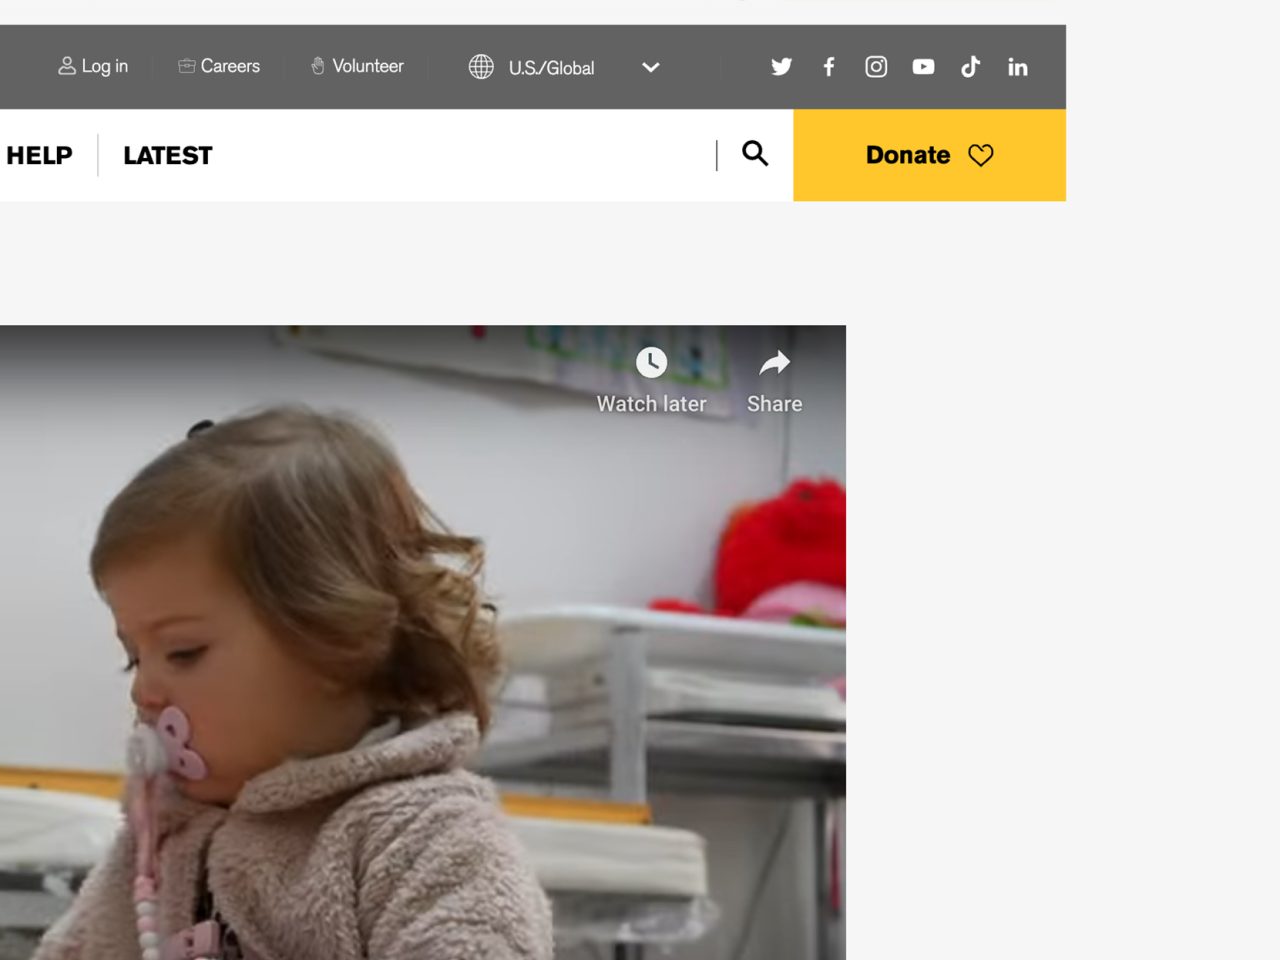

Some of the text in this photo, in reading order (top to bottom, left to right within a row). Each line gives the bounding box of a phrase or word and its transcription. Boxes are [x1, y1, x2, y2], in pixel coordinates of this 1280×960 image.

[83, 58, 128, 78] Log in
[202, 58, 260, 73] Careers
[333, 58, 404, 73] Volunteer
[510, 59, 594, 76] U.S./Global
[1008, 57, 1028, 76] in
[7, 145, 72, 165] HELP
[124, 145, 213, 165] LATEST
[866, 145, 951, 165] Donate
[596, 394, 706, 412] Watch later
[747, 394, 802, 412] Share
